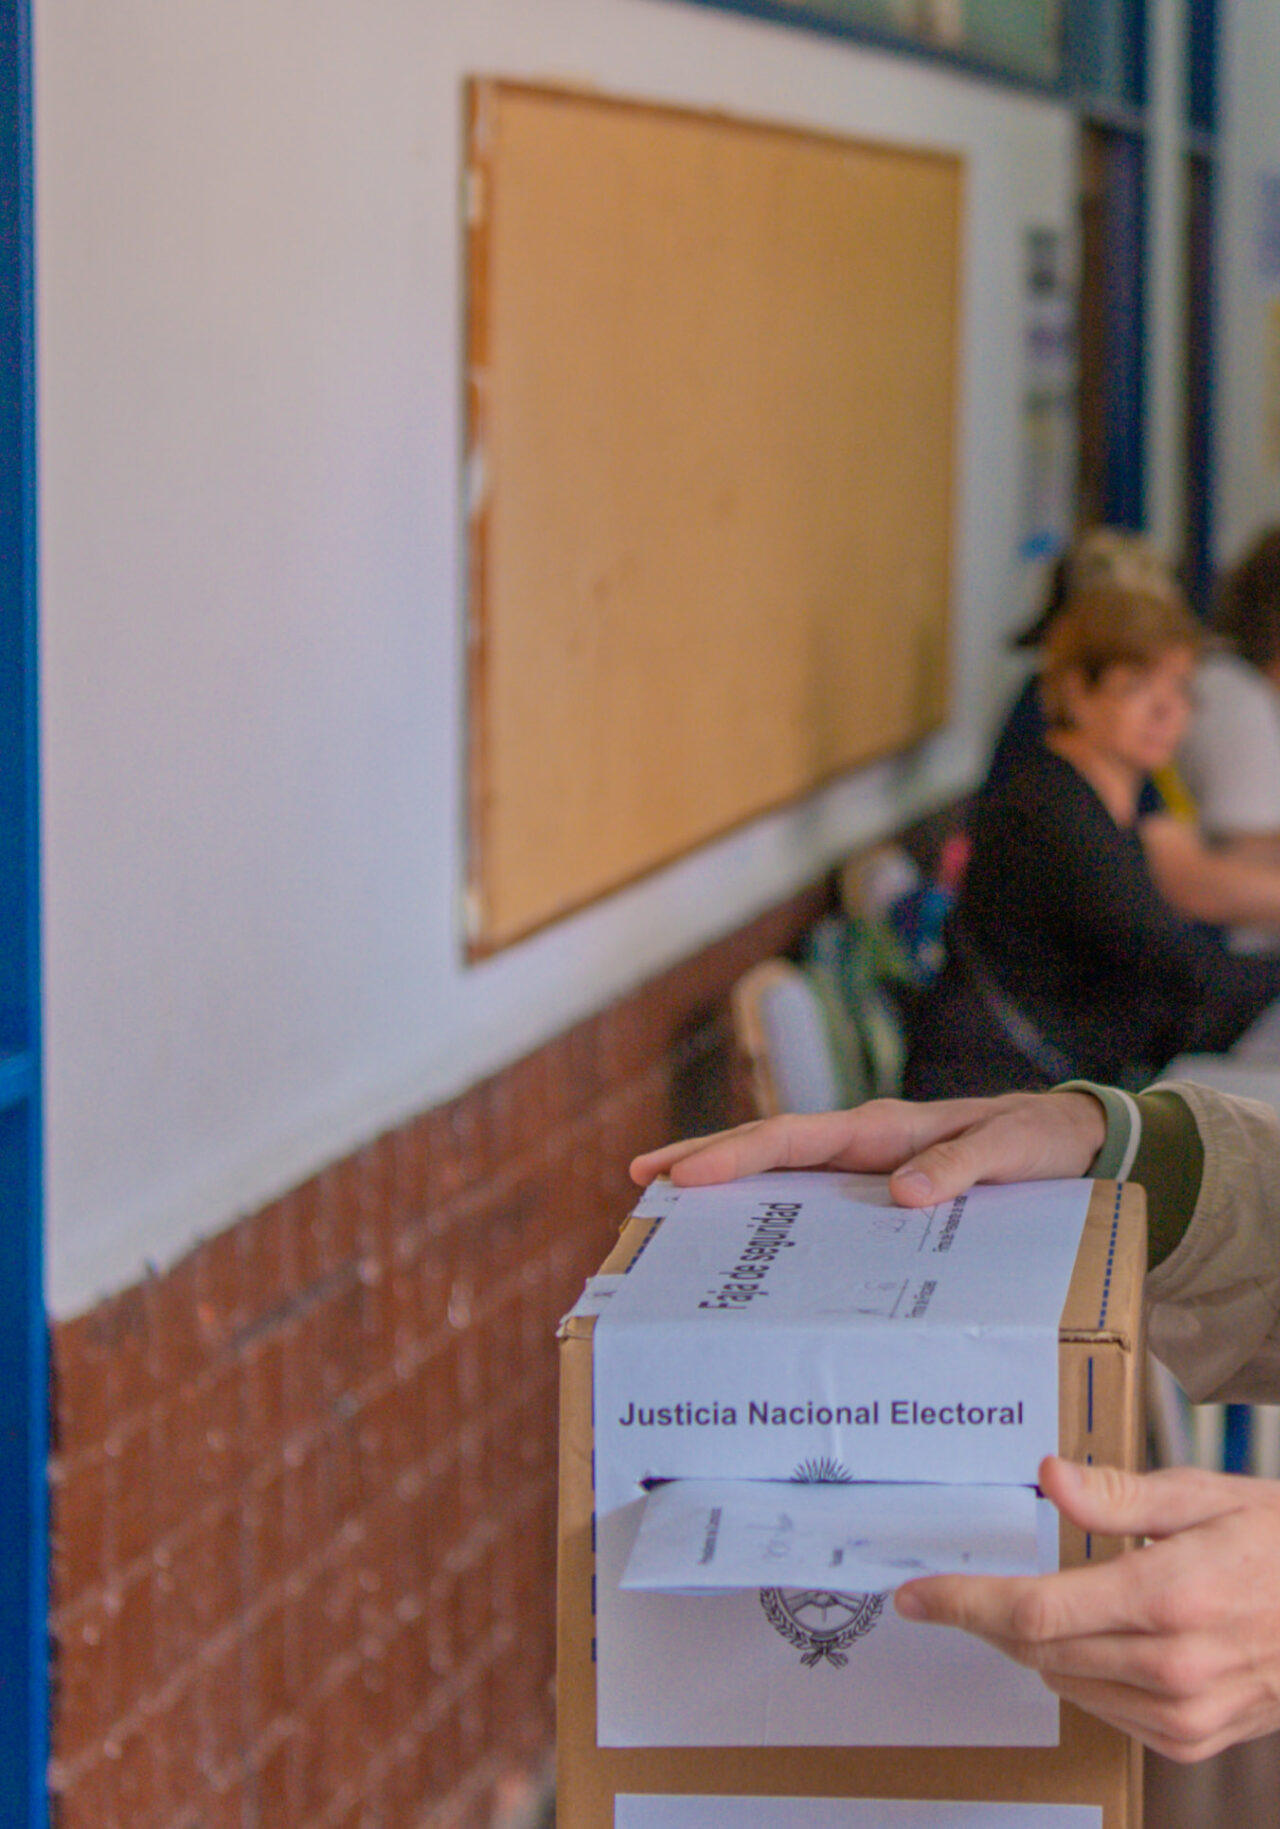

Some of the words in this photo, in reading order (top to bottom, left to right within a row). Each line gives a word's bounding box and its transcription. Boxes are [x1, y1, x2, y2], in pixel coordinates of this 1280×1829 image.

[739, 1203, 803, 1262] seguridad
[718, 1265, 770, 1280] de
[698, 1284, 769, 1309] Faja
[619, 1402, 738, 1426] Justicia
[748, 1401, 879, 1426] Nacional
[890, 1401, 1024, 1426] Electoral
